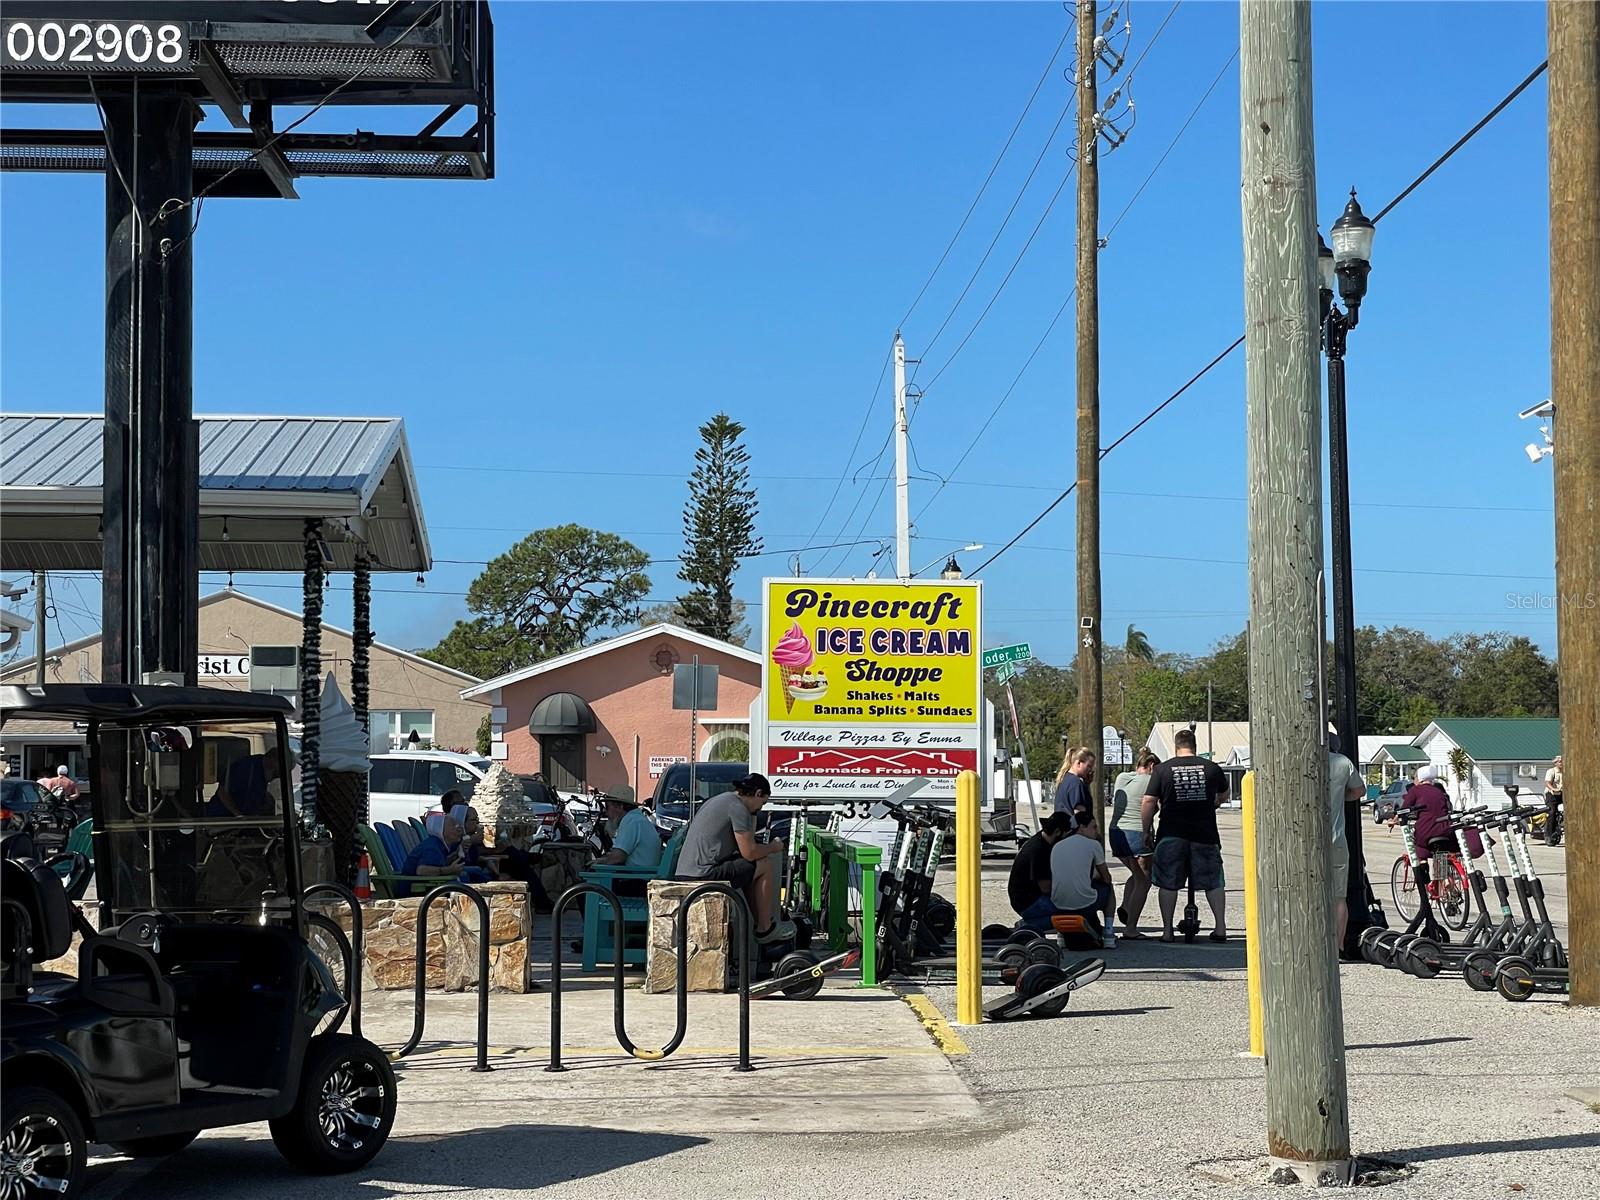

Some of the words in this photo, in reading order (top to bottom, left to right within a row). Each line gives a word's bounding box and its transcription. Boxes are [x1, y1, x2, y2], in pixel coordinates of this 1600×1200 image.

[7, 22, 183, 63] 002908
[785, 588, 962, 625] Pinecraft
[816, 628, 865, 655] ICE
[870, 628, 972, 656] CREAM
[845, 658, 943, 687] Shoppe
[847, 691, 894, 701] Shakes
[904, 691, 941, 702] Malts
[814, 704, 864, 715] Banana
[868, 705, 907, 716] Splits
[917, 705, 973, 716] Sundaes
[781, 730, 832, 746] Village
[839, 730, 887, 746] Pizzas
[892, 731, 911, 746] By
[917, 731, 964, 744] Emma
[776, 766, 871, 774] Homemade
[773, 778, 800, 789] Open
[803, 780, 819, 790] for
[822, 779, 857, 789] Lunch
[860, 780, 881, 789] and
[927, 832, 945, 874] TWRP
